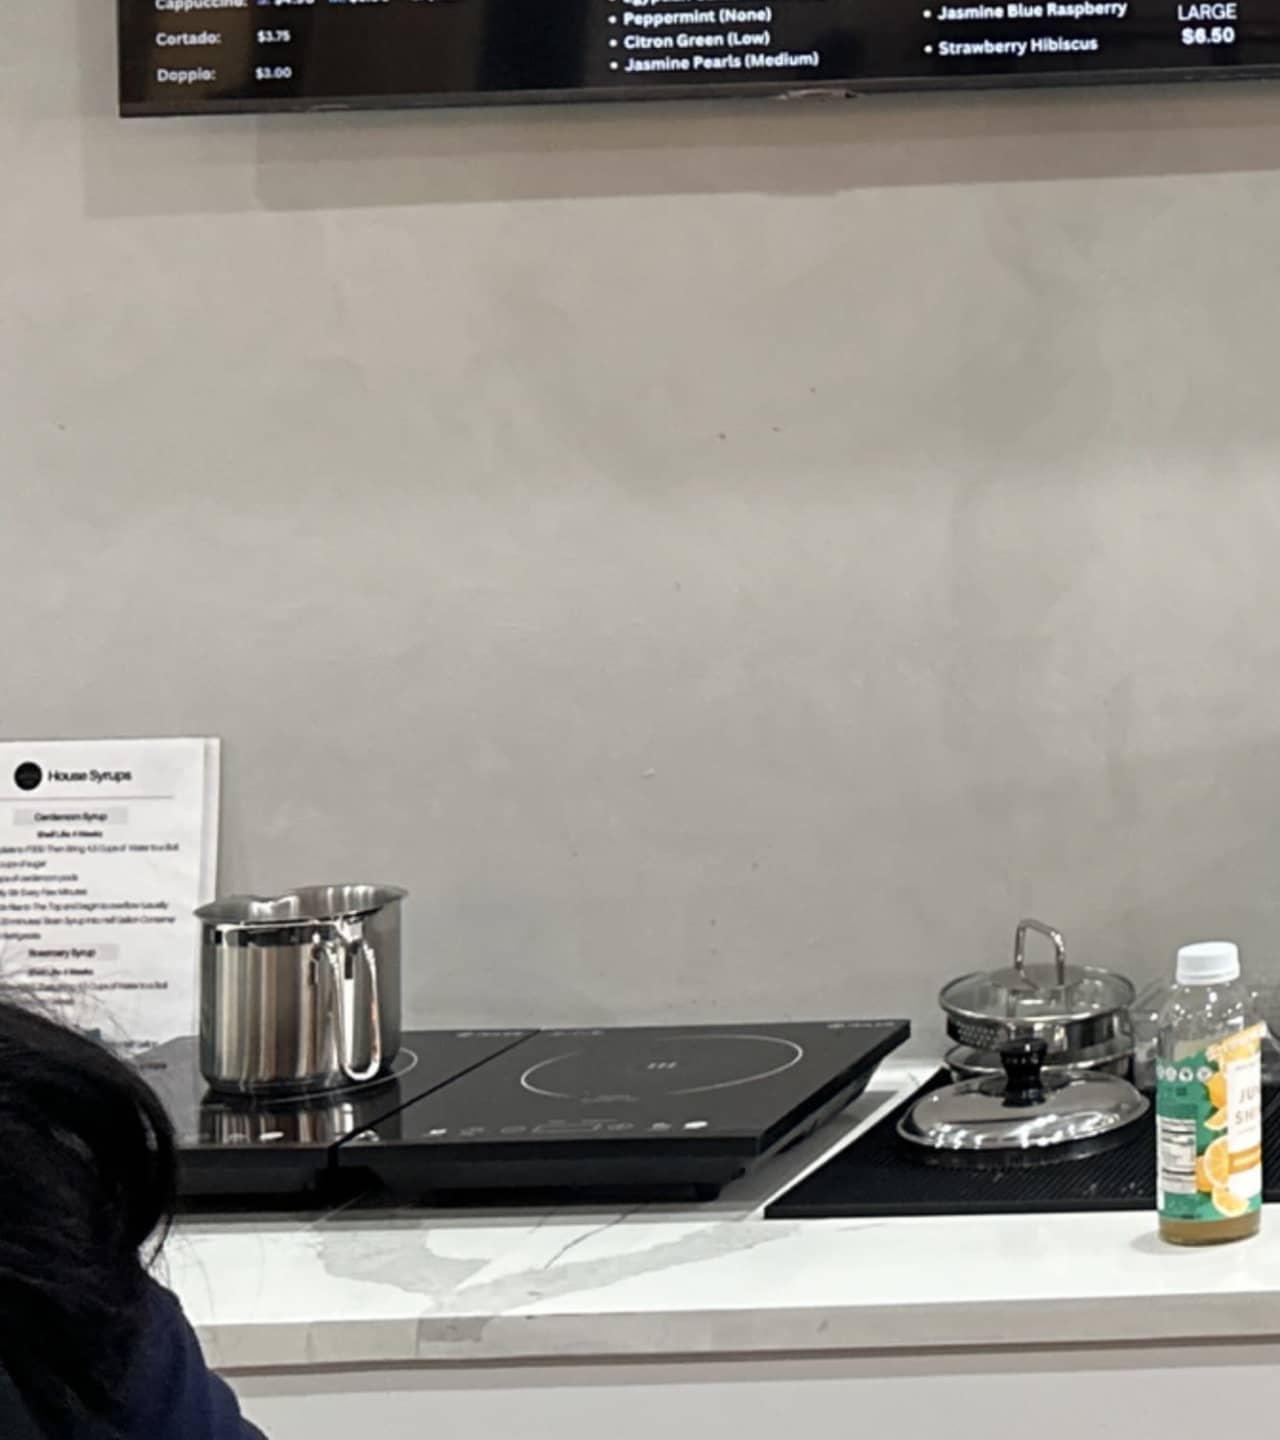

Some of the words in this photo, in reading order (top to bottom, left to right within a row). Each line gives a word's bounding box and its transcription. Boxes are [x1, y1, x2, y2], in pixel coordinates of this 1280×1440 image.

[623, 10, 716, 29] Peppermint
[719, 8, 772, 24] (None)
[1178, 2, 1237, 21] LARGE
[156, 32, 221, 46] Cortado:
[624, 35, 673, 49] Citron
[676, 34, 724, 48] Green
[727, 31, 770, 47] (Low)
[1182, 27, 1235, 46] $6.50
[624, 57, 689, 72] Jasmine
[693, 55, 741, 70] Pearls
[745, 52, 819, 69] (Medium)
[157, 68, 216, 84] Doppio:
[48, 770, 87, 782] House
[89, 770, 132, 783] Syrups
